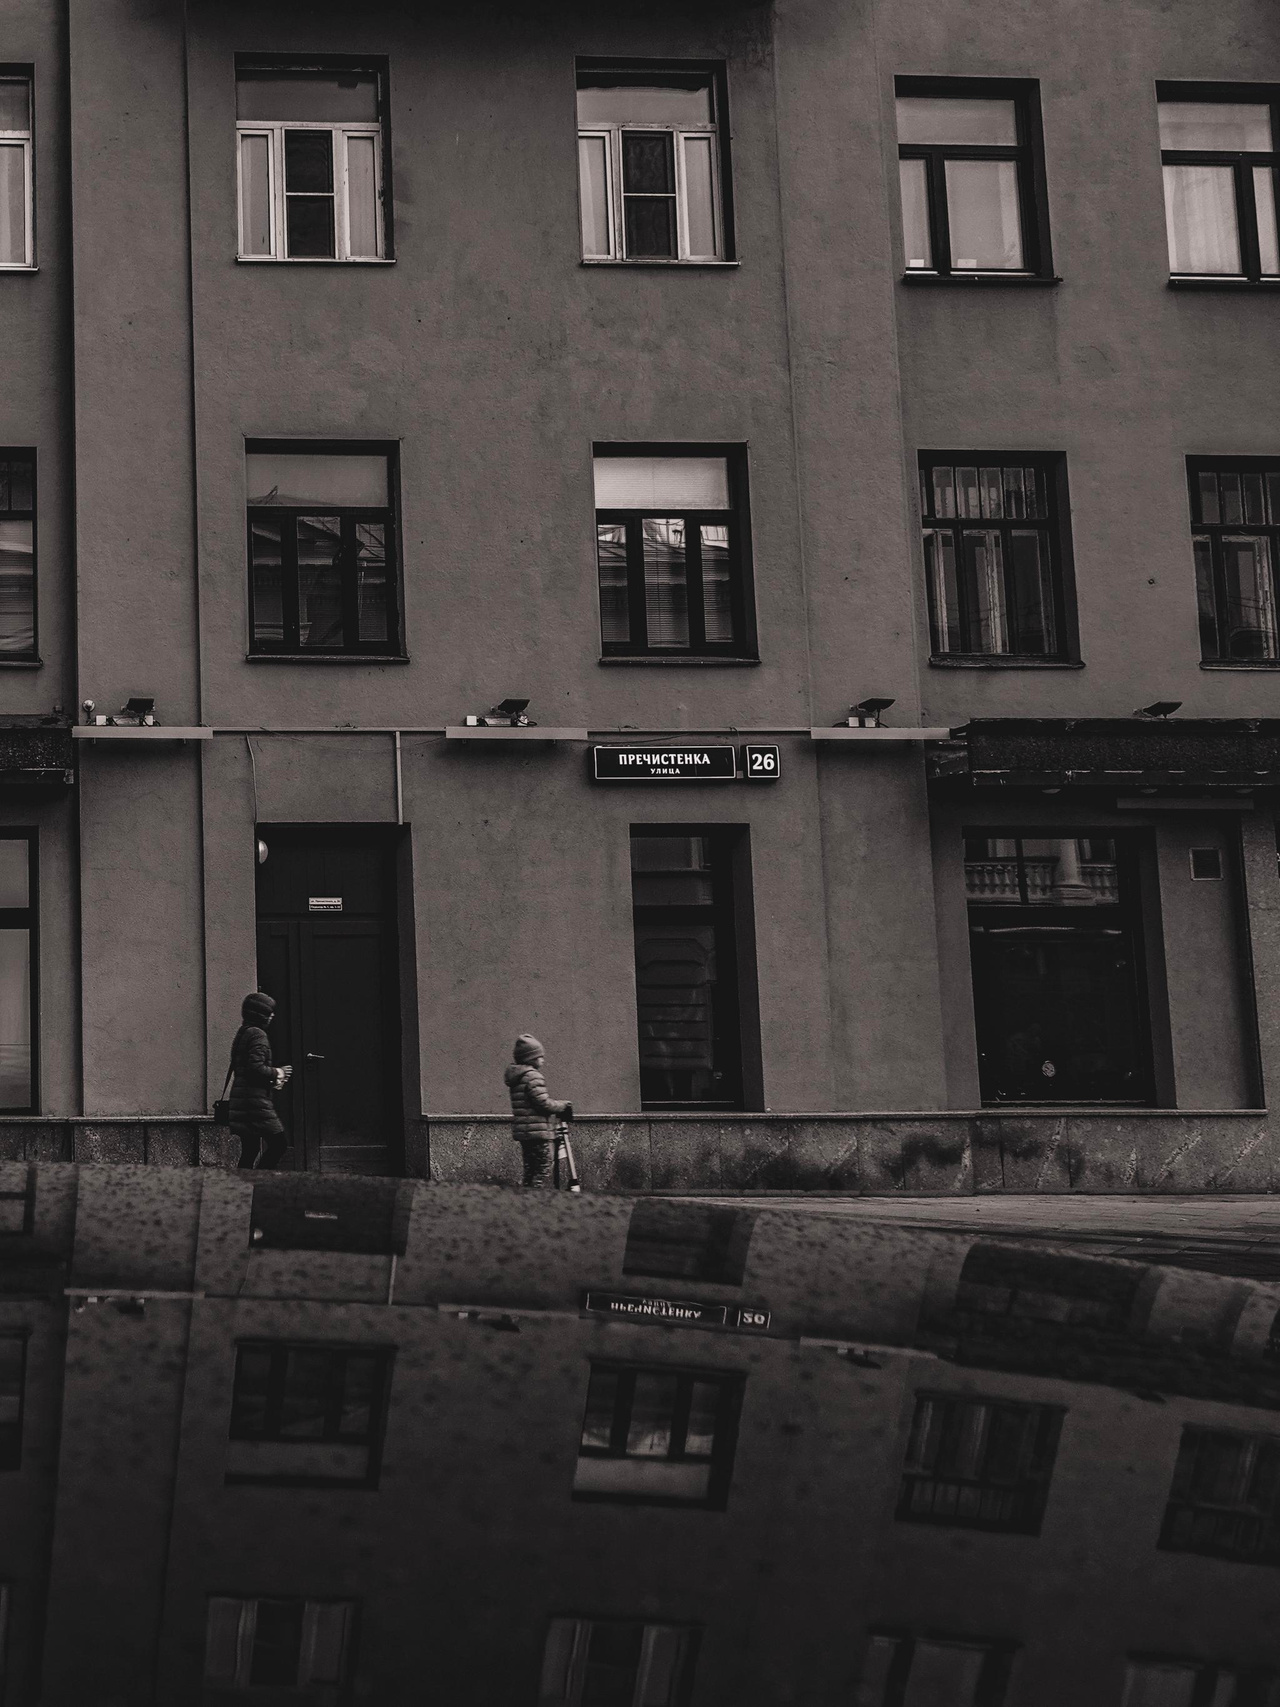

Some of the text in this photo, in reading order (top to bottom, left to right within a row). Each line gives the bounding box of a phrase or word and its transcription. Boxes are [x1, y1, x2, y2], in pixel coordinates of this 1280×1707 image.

[619, 753, 711, 765] ПРЕЧИСТЕНКА
[751, 753, 775, 770] 26
[650, 767, 681, 775] УЛИЦА
